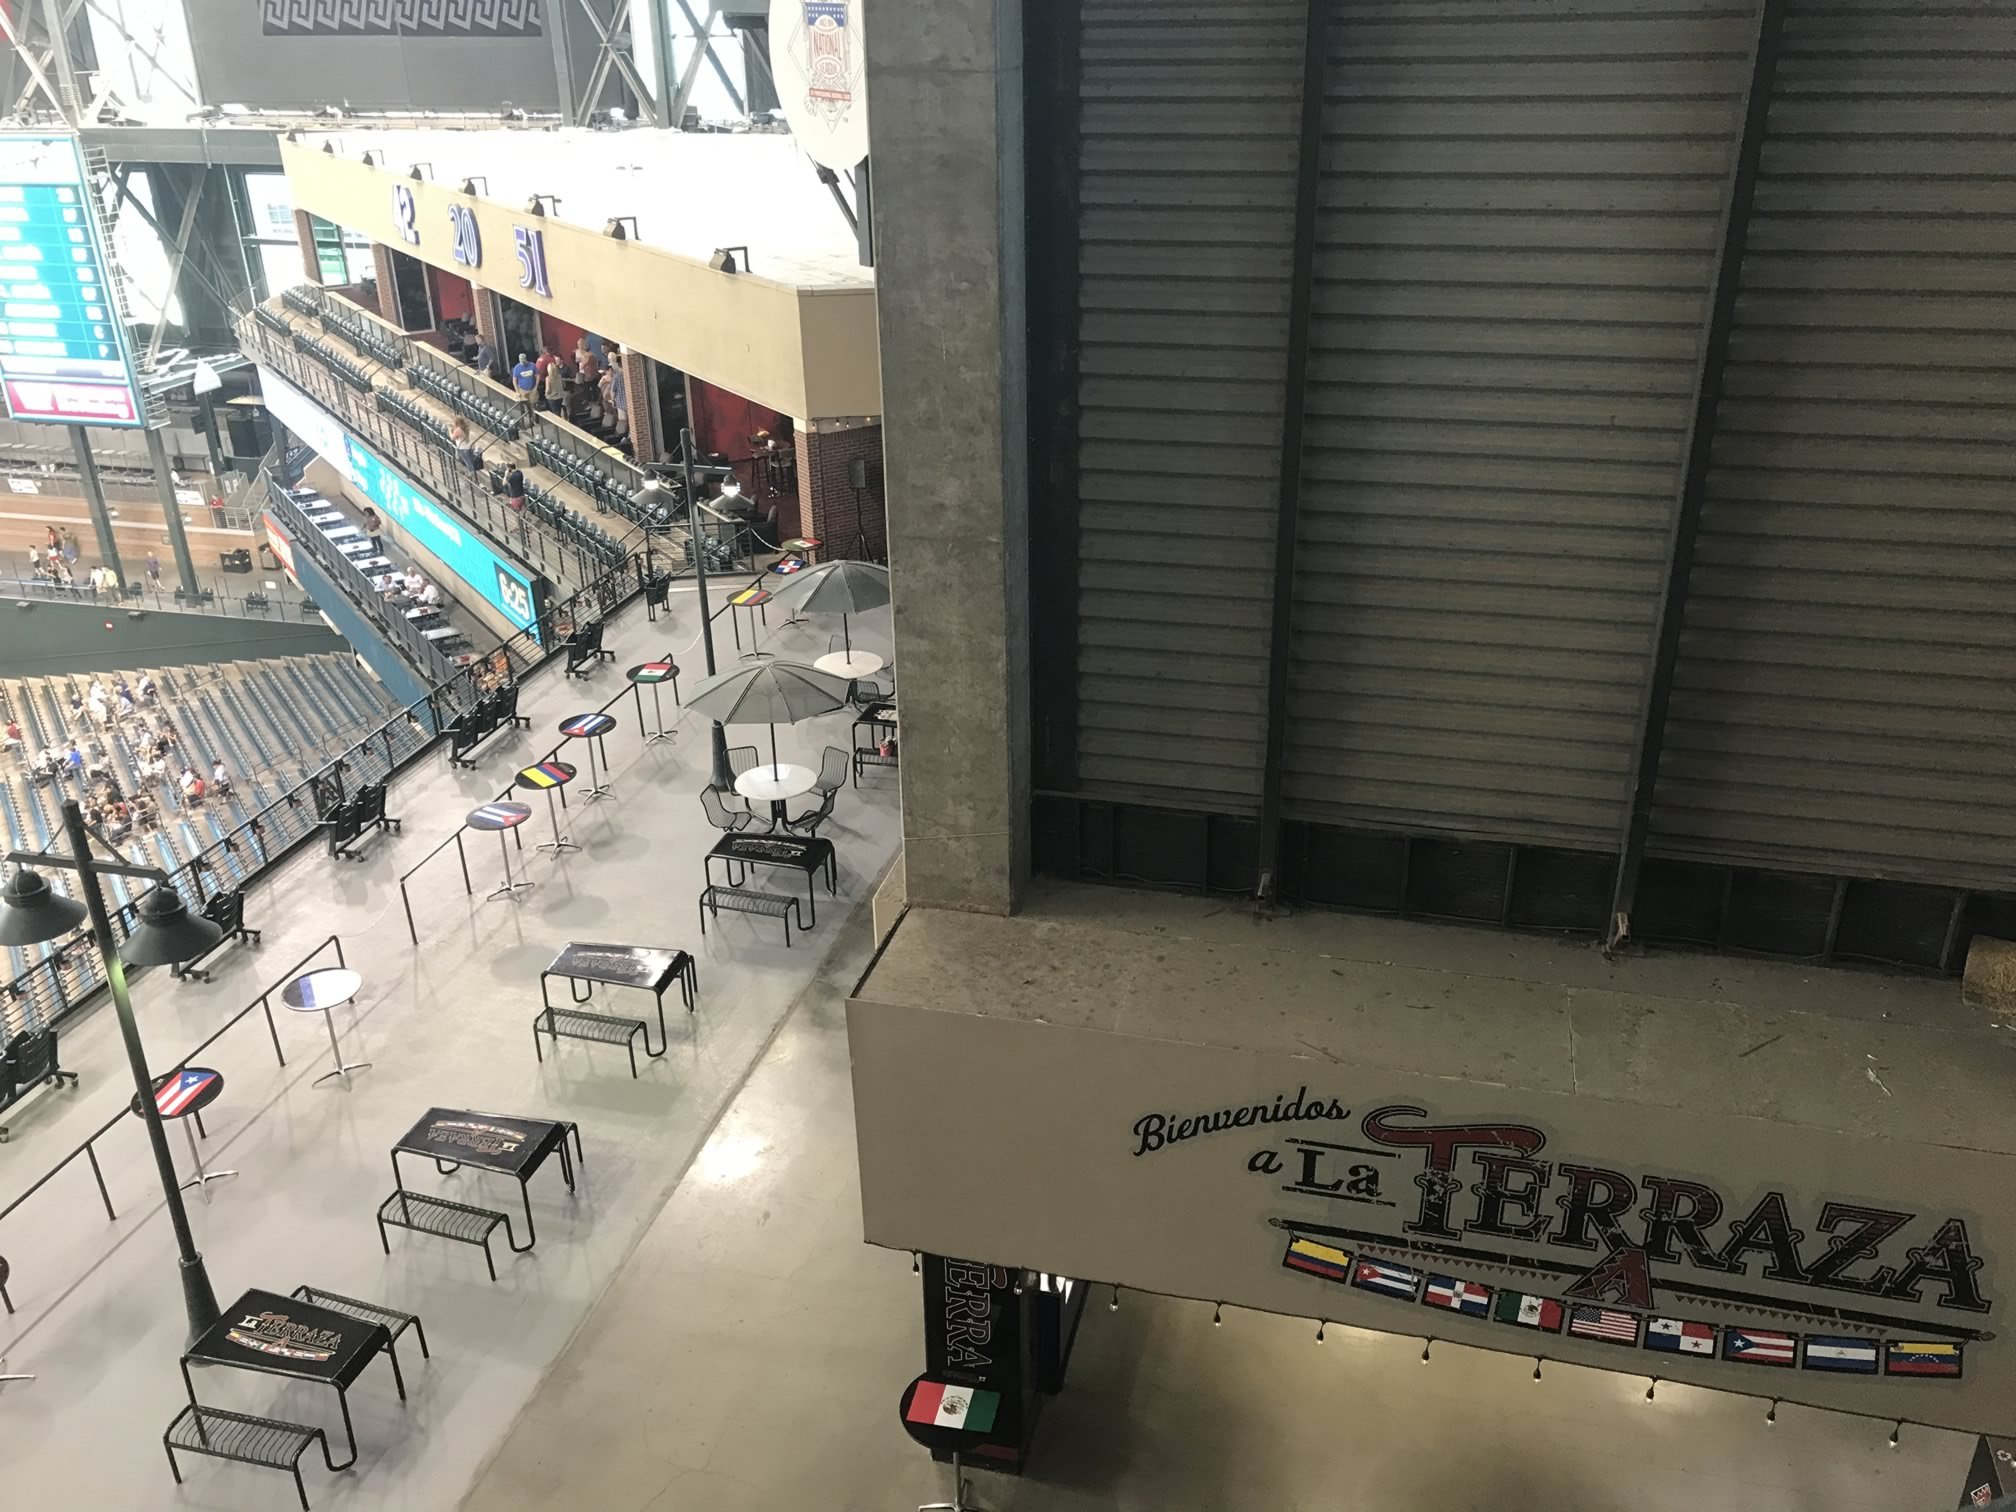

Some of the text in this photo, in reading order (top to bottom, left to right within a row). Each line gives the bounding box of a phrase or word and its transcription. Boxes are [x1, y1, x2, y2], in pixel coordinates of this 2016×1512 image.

[814, 30, 841, 61] NATIONAL
[449, 204, 482, 269] 20
[513, 225, 553, 298] 51
[427, 1128, 504, 1154] TERRAZA
[1132, 1087, 1351, 1156] Bienvenidos
[1248, 1105, 1992, 1312] a La TERRAZA
[238, 1311, 342, 1349] La TERRAZA
